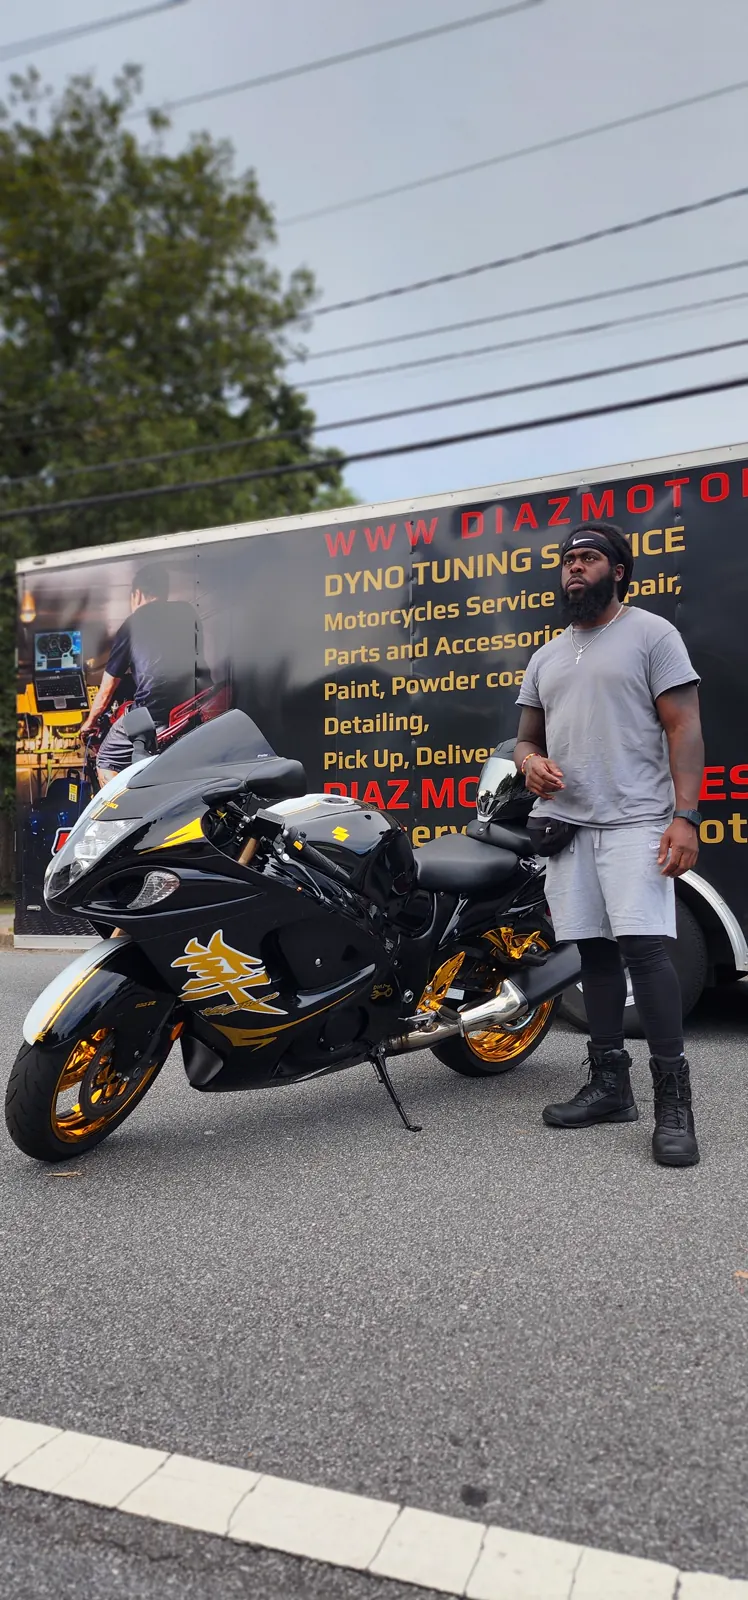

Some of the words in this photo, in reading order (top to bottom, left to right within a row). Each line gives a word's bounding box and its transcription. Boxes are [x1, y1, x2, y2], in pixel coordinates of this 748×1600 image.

[325, 565, 404, 597] DYNO
[412, 547, 533, 586] TUNING
[541, 525, 686, 570] SICE
[324, 601, 460, 632] Motorcycles
[466, 590, 556, 616] Service
[623, 572, 682, 604] pair,
[324, 643, 381, 667] Parts
[386, 637, 428, 661] and
[434, 625, 565, 656] Accessorie
[324, 679, 386, 701] Paint,
[392, 670, 480, 696] Powder
[486, 669, 527, 688] coa
[324, 711, 430, 736] Detailing,
[324, 749, 369, 770] Pick
[374, 749, 410, 773] Up,
[416, 744, 495, 767] Delive
